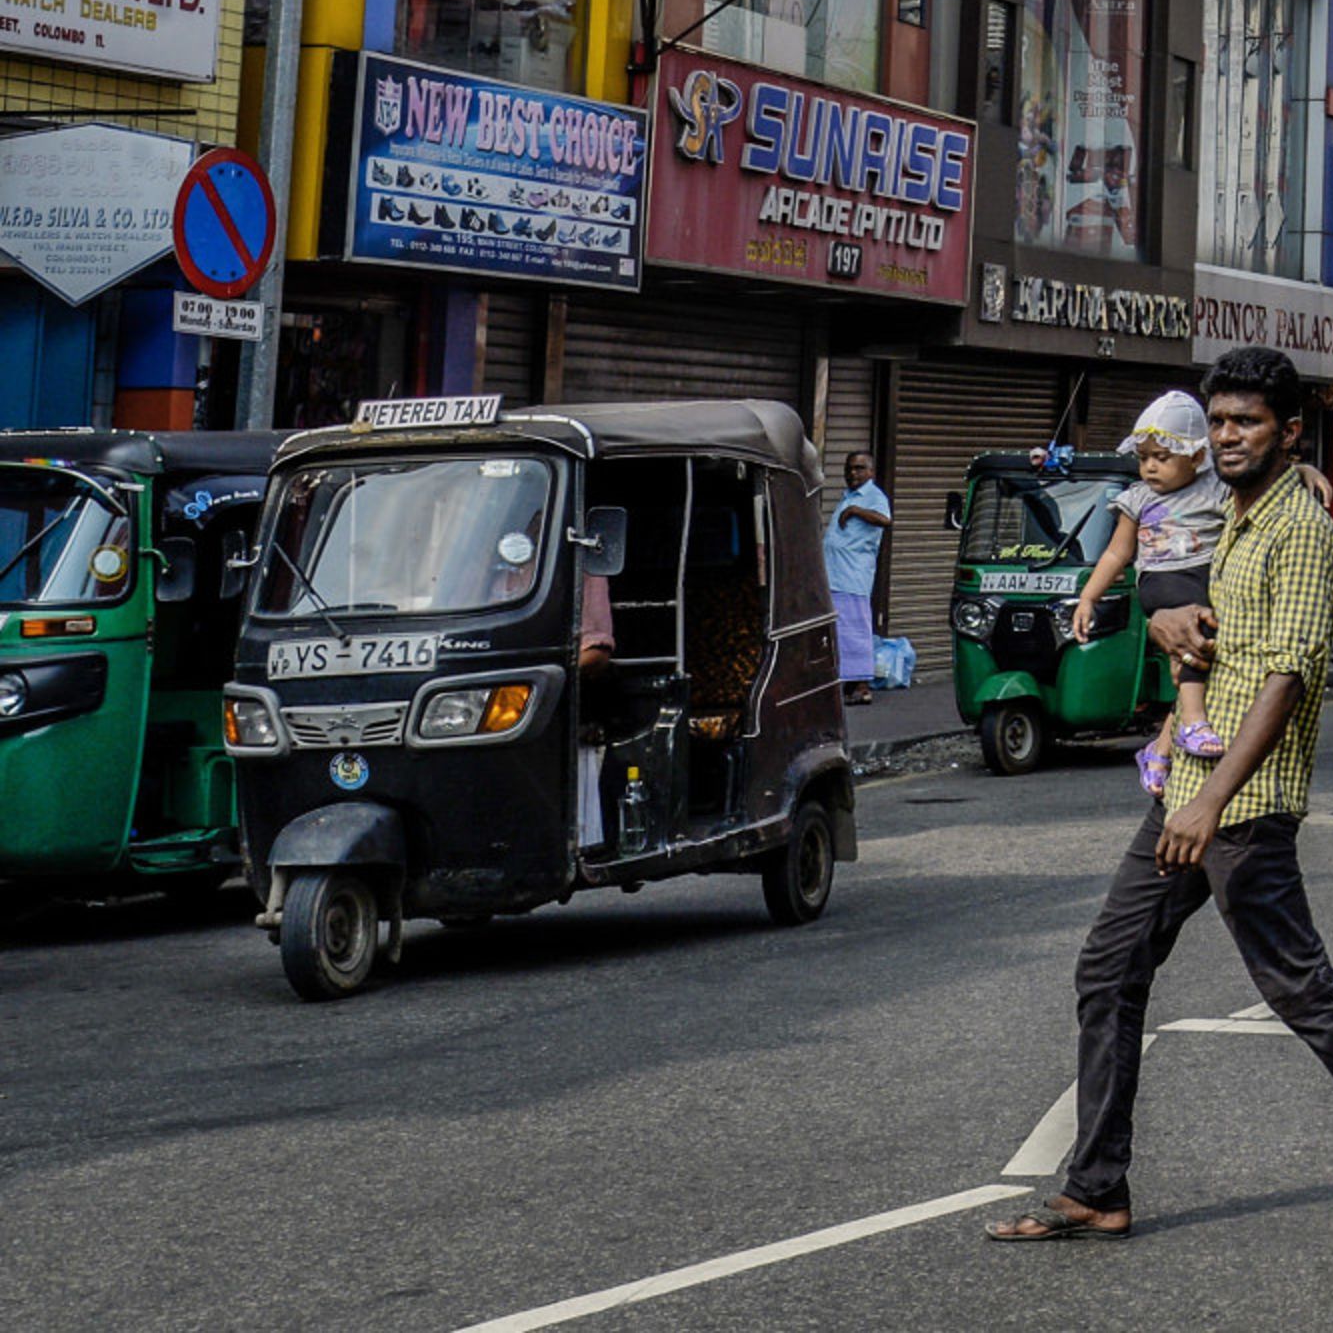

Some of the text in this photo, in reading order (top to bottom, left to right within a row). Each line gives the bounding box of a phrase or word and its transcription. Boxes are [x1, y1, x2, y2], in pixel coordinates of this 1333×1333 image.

[33, 22, 86, 45] COLOMBO
[404, 76, 473, 148] NEW
[476, 90, 546, 160] BEST
[549, 105, 638, 175] CHOICE
[740, 82, 970, 213] SUNRISE
[47, 207, 91, 229] SILVA
[95, 210, 107, 229] &
[759, 185, 853, 237] ARCADE
[907, 215, 945, 251] LTD
[834, 246, 860, 274] 197
[1013, 274, 1191, 339] KARUNA STORES
[1193, 296, 1267, 345] PRINCE
[363, 398, 497, 426] METERED TAXI
[1036, 576, 1075, 592] 1571
[296, 639, 433, 672] YS 7416
